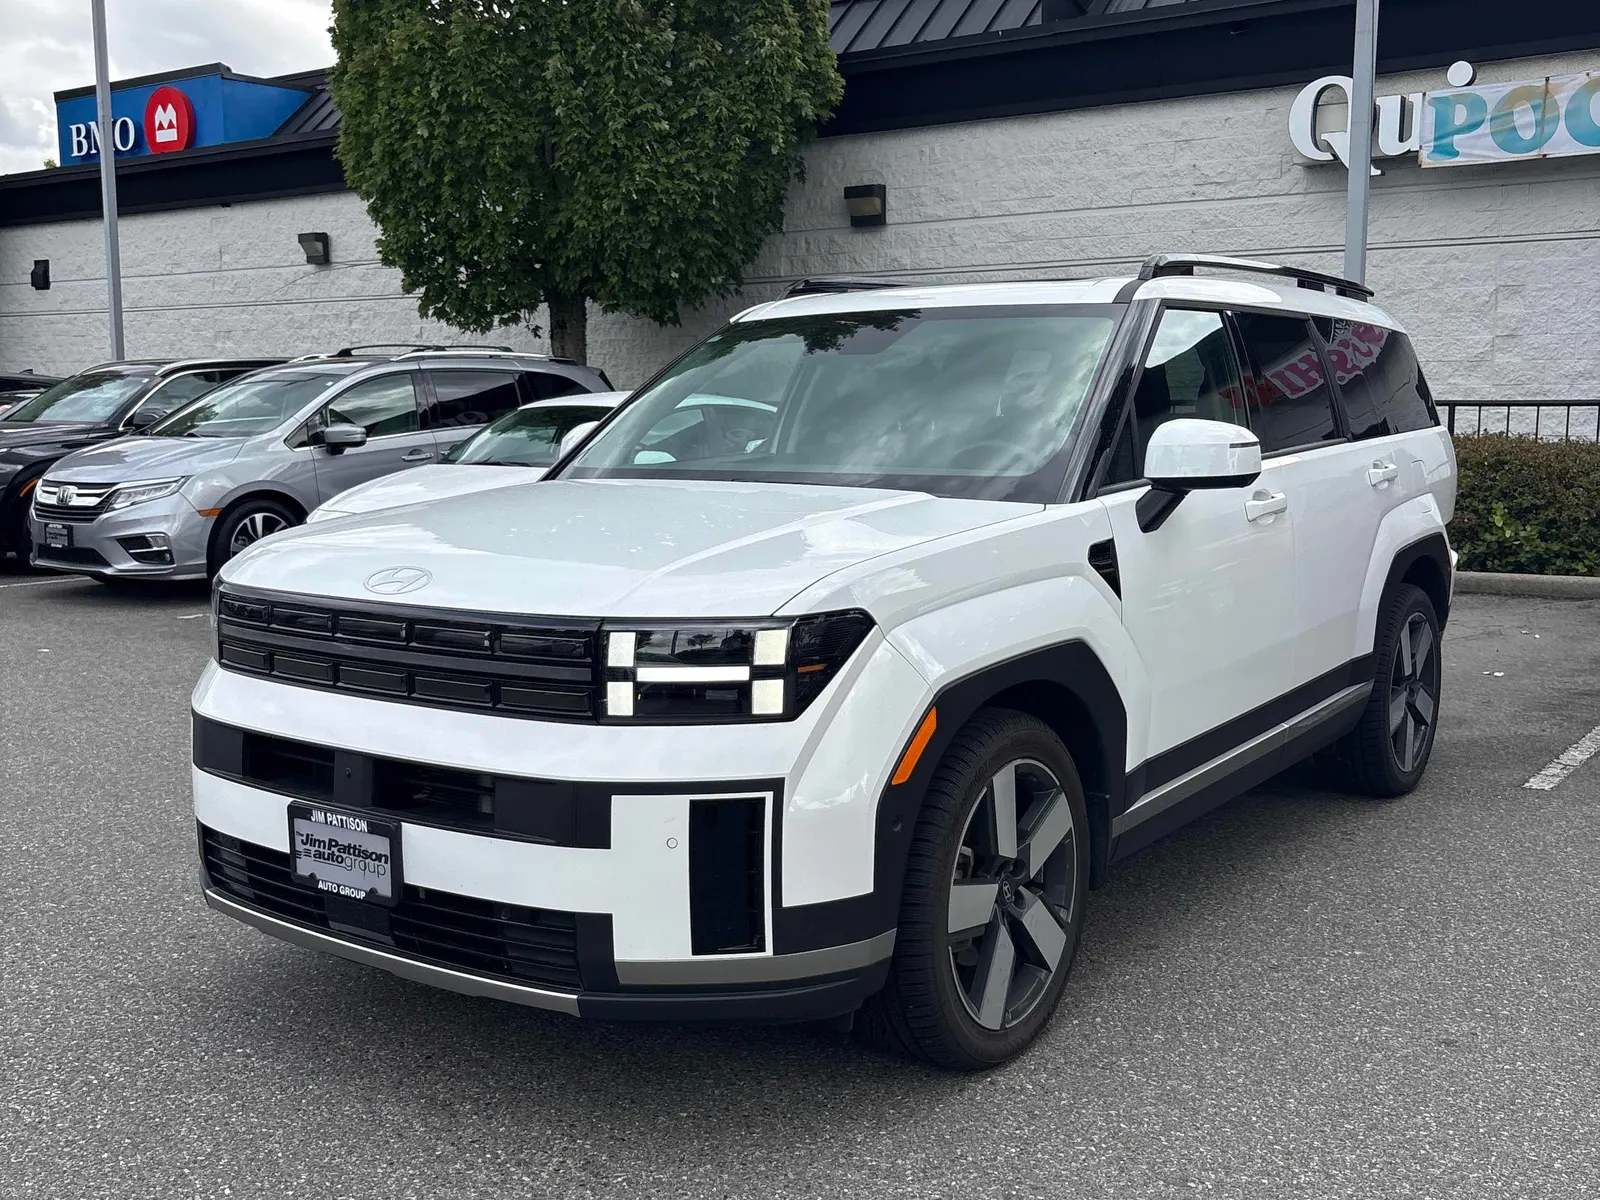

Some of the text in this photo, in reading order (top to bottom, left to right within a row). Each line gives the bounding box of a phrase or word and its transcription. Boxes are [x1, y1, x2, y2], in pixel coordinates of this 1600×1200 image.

[1288, 60, 1473, 176] Qu
[311, 809, 368, 833] JIM PATTISON
[300, 833, 389, 865] Jim Pattison
[317, 880, 366, 900] AUTO GROUP
